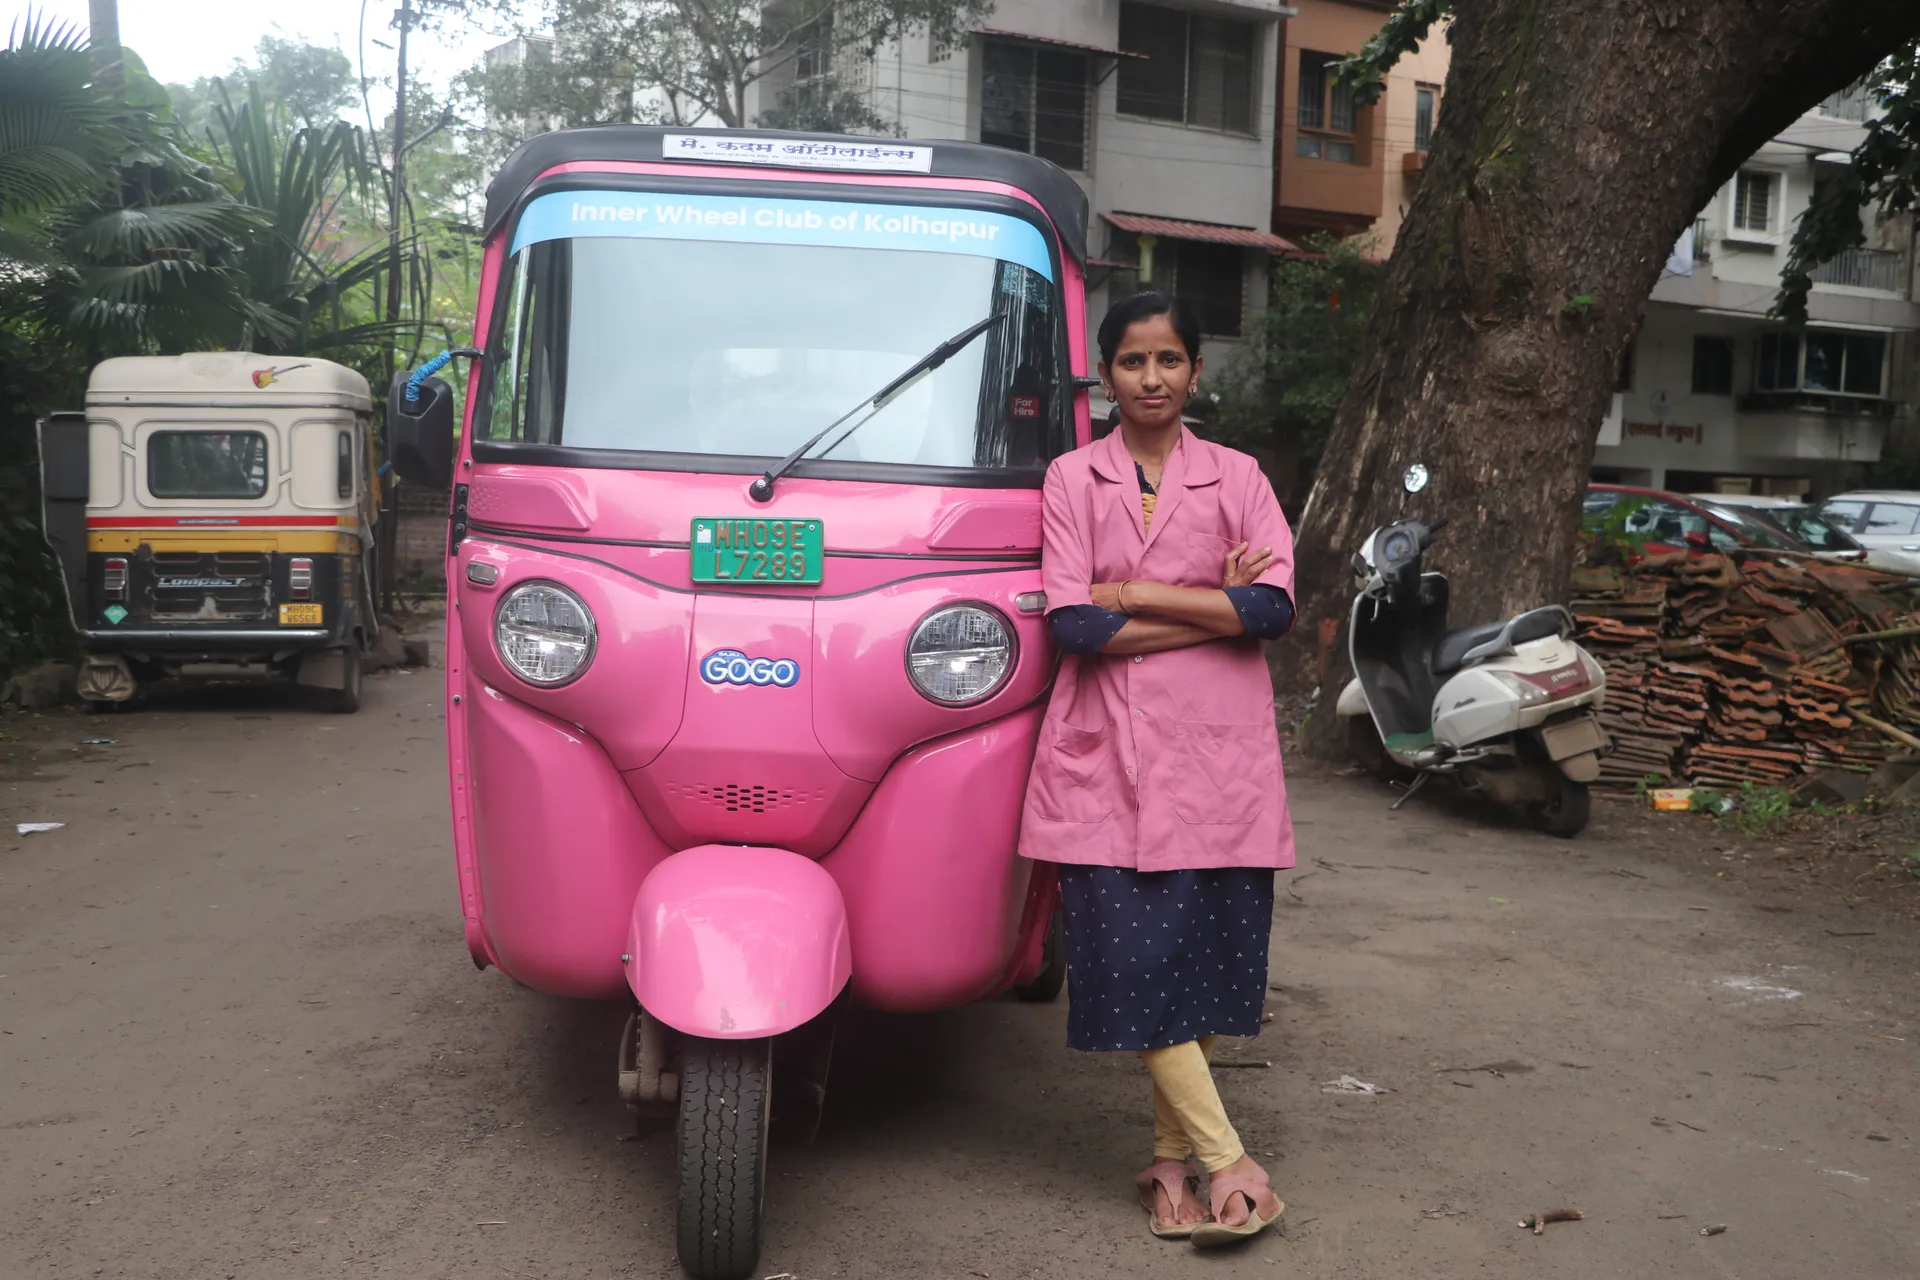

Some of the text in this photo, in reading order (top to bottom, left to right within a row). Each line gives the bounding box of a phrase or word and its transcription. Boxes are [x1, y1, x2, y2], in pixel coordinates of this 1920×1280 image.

[716, 141, 774, 152] कदम
[572, 202, 1000, 242] Inner Wheel Club of Kolhapur
[1014, 407, 1035, 416] Hire
[1015, 398, 1033, 407] For
[715, 520, 806, 549] MH09E
[715, 550, 806, 579] L7289
[705, 657, 795, 684] GOGO
